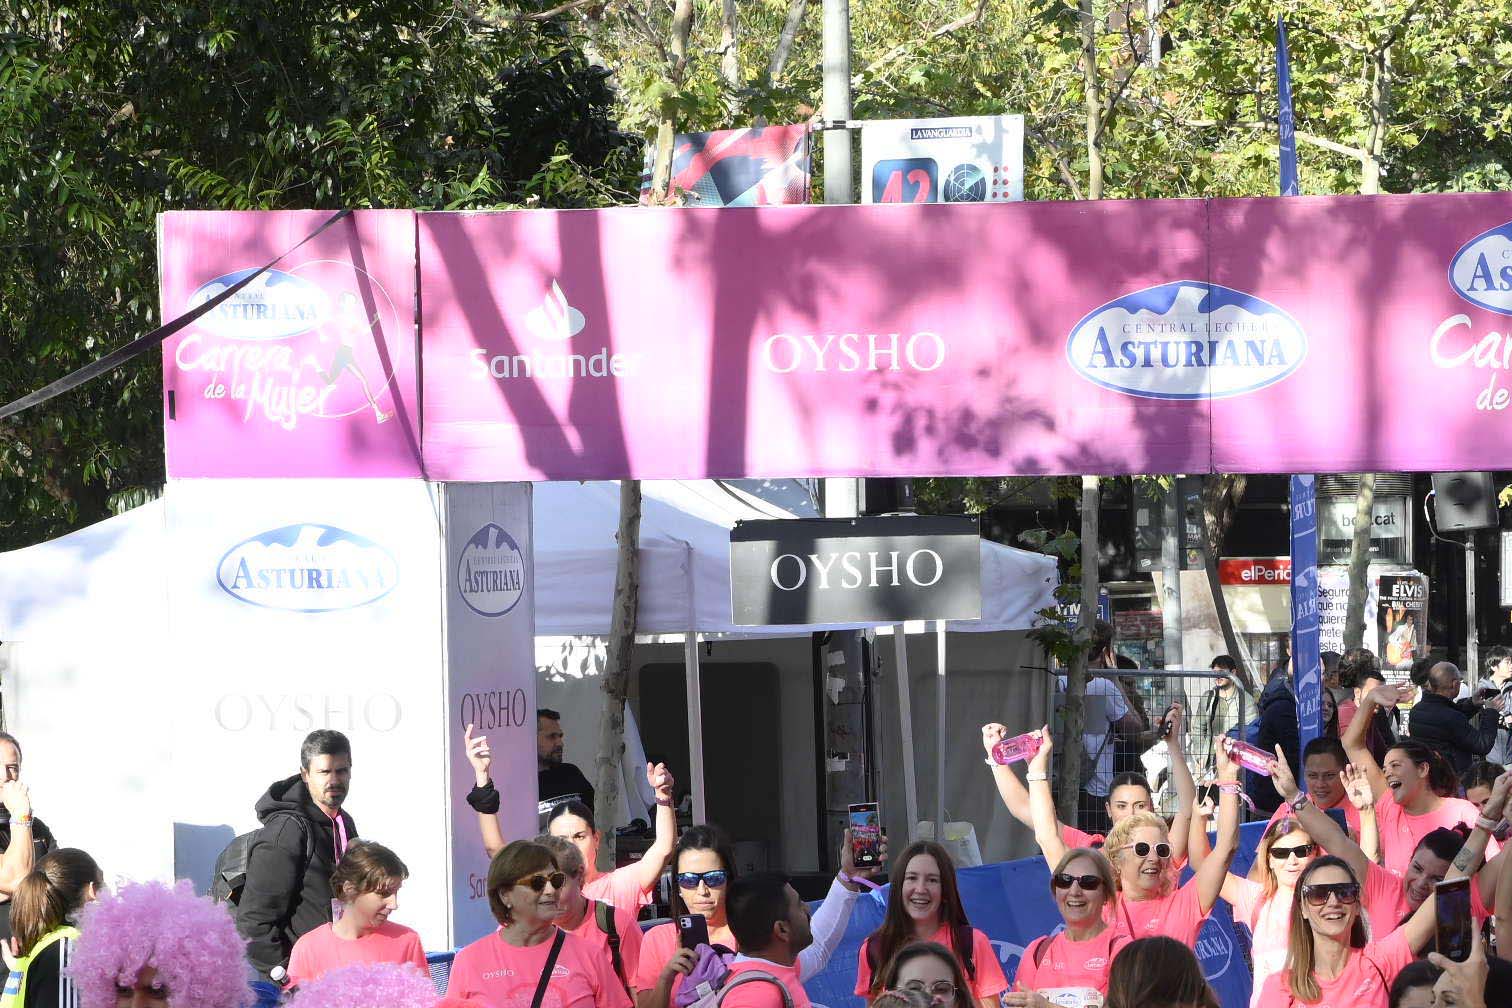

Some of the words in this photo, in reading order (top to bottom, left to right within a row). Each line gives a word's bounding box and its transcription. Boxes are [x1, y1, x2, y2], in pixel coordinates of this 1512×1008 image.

[1087, 325, 1288, 369] ASTURIANA
[1121, 322, 1197, 334] CENTRAL
[175, 333, 294, 372] Carrera
[468, 348, 641, 378] Santander
[762, 331, 946, 374] OYSHO
[204, 374, 226, 399] de
[243, 365, 336, 429] Mujer
[1476, 372, 1511, 411] de
[231, 556, 387, 590] ASTURIANA
[463, 559, 521, 594] ASTURIANA
[770, 549, 944, 591] OYSHO
[1392, 585, 1422, 597] ELVIS
[459, 687, 527, 733] OYSHO
